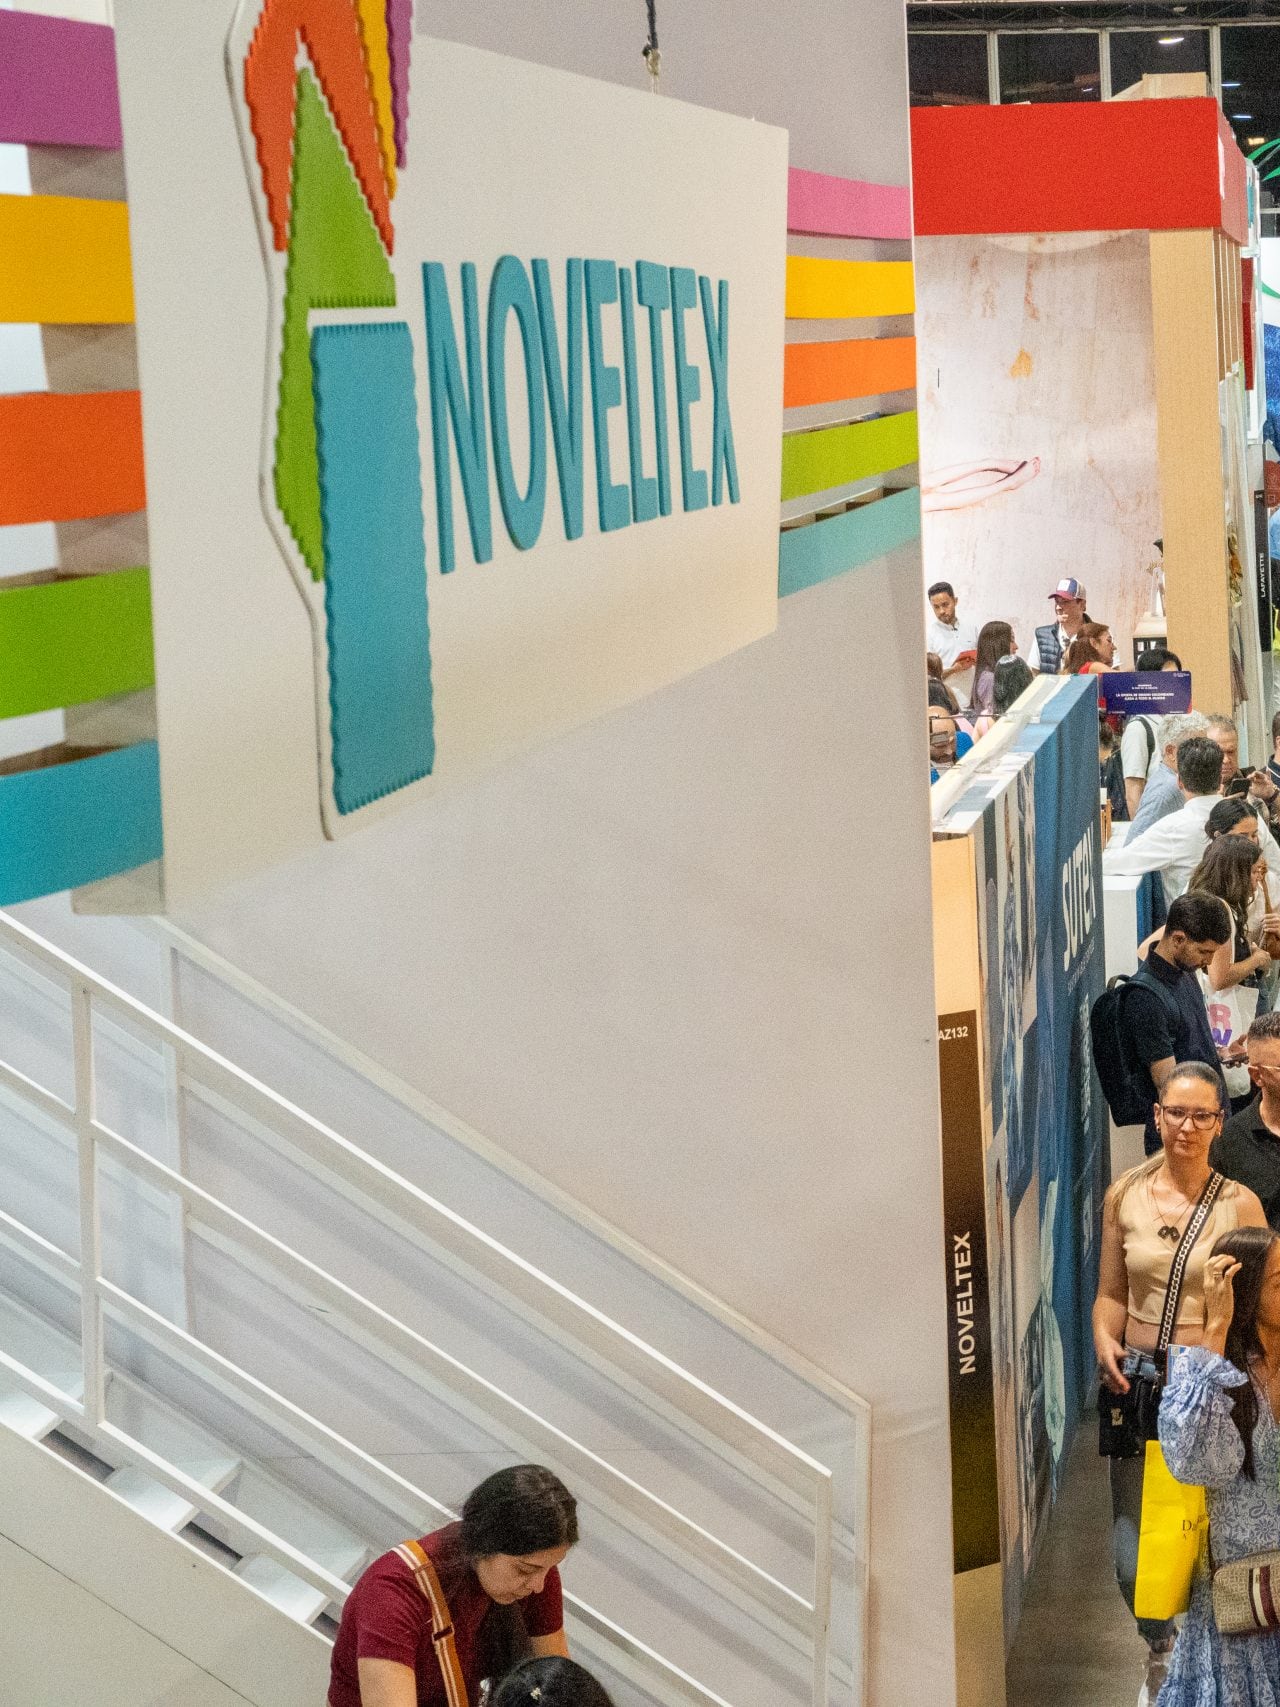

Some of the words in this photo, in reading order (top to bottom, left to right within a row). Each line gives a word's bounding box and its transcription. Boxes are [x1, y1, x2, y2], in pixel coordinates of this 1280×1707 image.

[421, 254, 740, 575] NOVELTEX
[937, 1026, 969, 1041] AZ132
[953, 1230, 976, 1375] NOVELTEX
